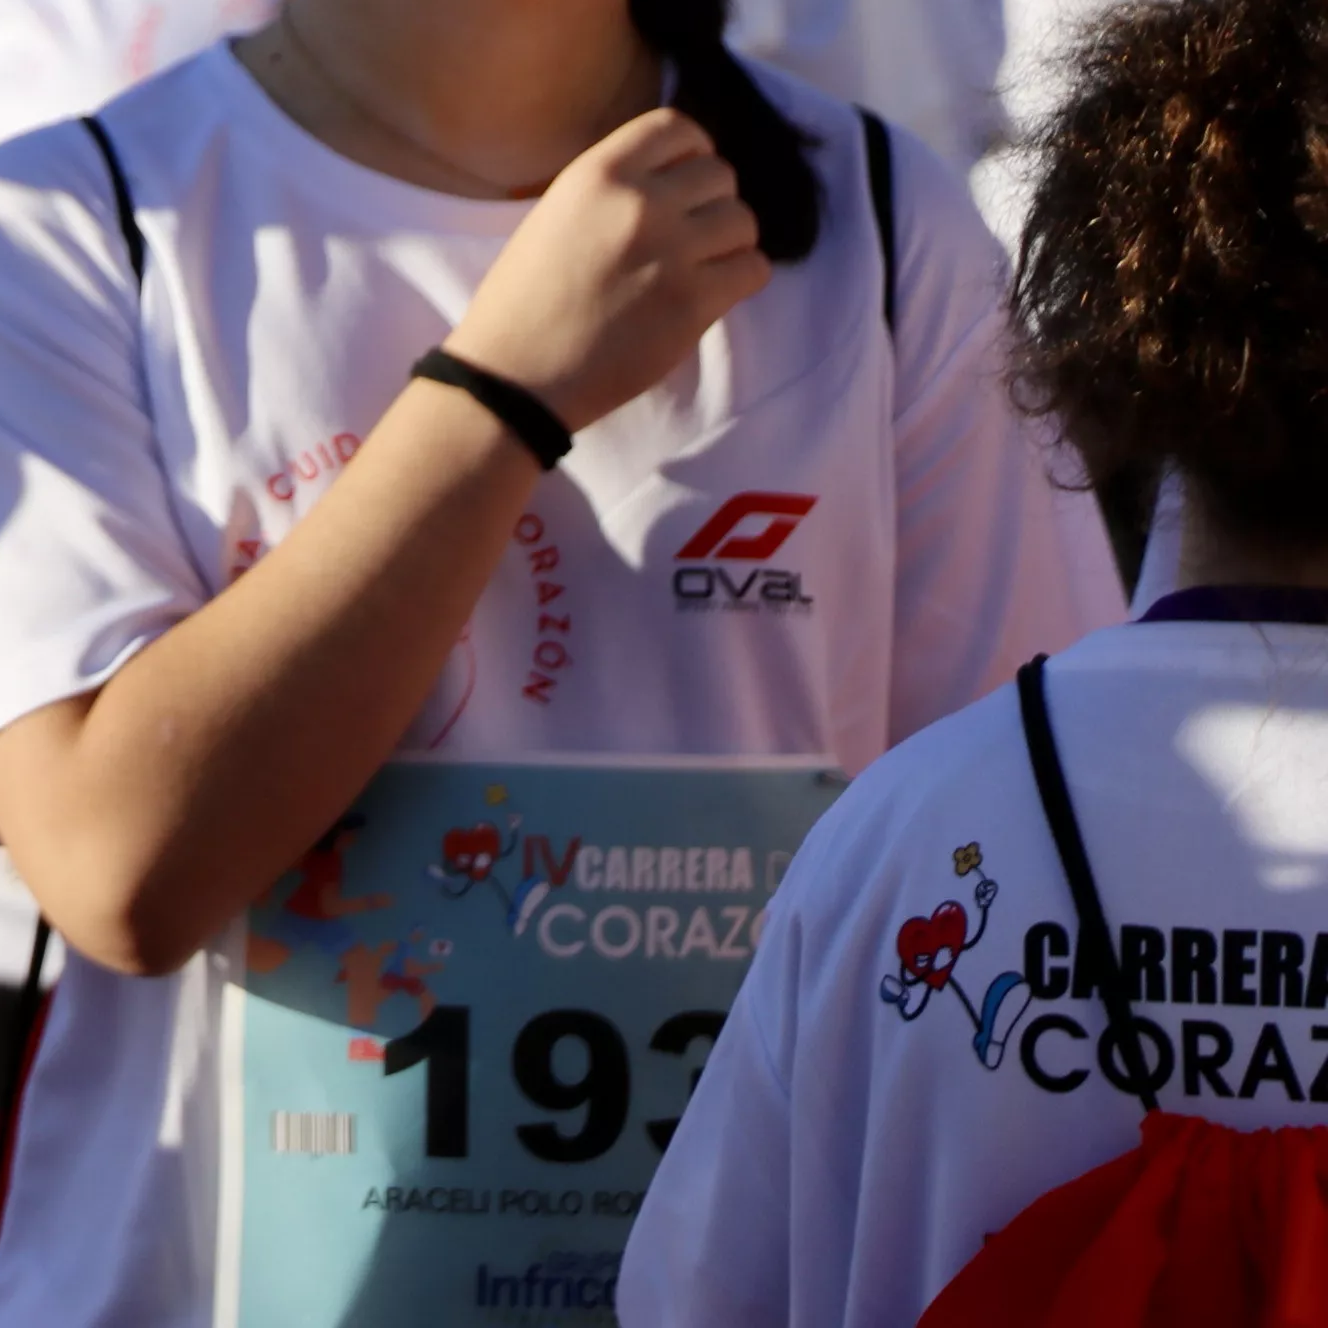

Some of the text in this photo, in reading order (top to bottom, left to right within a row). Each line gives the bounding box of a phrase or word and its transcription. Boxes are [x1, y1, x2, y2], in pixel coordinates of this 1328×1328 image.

[267, 432, 576, 706] CUID ORAZÓN
[522, 835, 582, 887] IV
[575, 845, 754, 893] CARRERA
[536, 903, 771, 960] CORAZ
[362, 1186, 490, 1214] ARACELI
[498, 1188, 584, 1217] POLO
